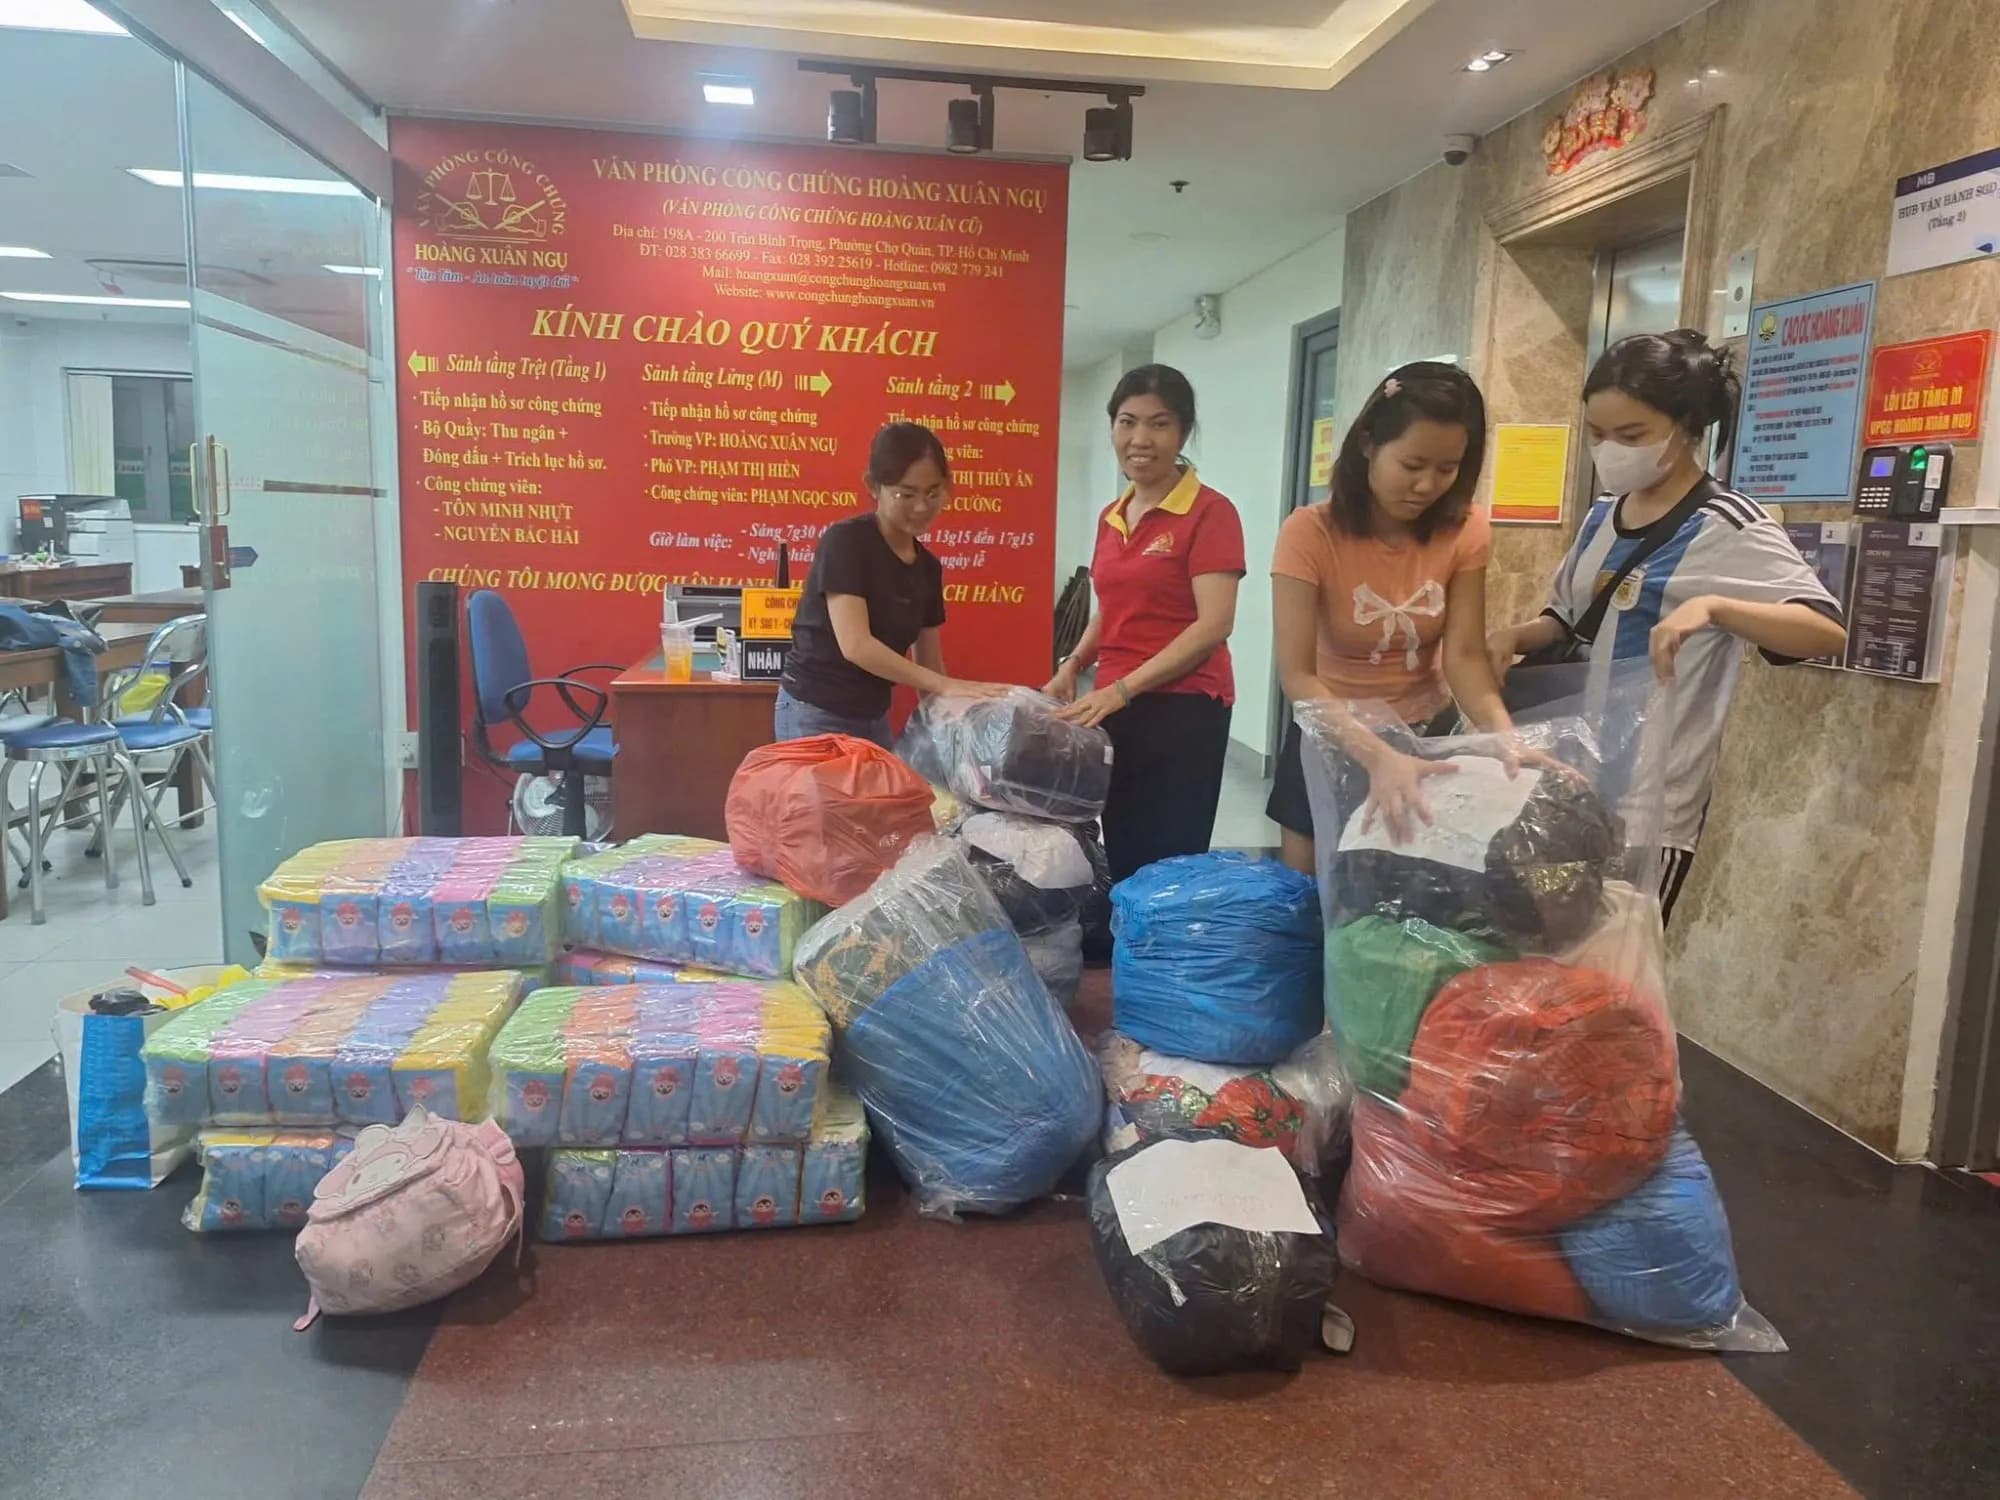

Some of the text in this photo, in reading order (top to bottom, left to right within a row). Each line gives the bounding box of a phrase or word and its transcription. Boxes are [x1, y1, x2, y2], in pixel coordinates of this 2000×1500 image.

[643, 160, 716, 186] PHÒNG
[722, 164, 782, 191] CÔNG
[788, 169, 862, 196] CHỨNG
[868, 174, 941, 202] HOÀNG
[946, 180, 1000, 205] XUÂN
[1007, 188, 1047, 214] NGỤ
[1916, 172, 1935, 189] MB
[703, 199, 754, 219] PHÒNG
[759, 203, 801, 222] CÔNG
[804, 206, 857, 227] CHỨNG
[860, 210, 912, 230] HOÀNG
[915, 214, 956, 232] XUÂN
[415, 240, 568, 272] HOÀNG XUÂN NGỤ
[640, 244, 661, 257] ĐT:
[663, 228, 694, 242] 198A
[705, 230, 725, 243] 200
[1001, 249, 1030, 263] Minh
[714, 283, 762, 299] Website:
[530, 303, 938, 357] KÍNH CHÀO QUÝ KHÁCH
[446, 351, 607, 383] Sảnh tầng Trệt (Tầng 1)
[642, 363, 679, 383] Sảnh
[683, 360, 713, 389] tầng
[758, 370, 783, 391] (M)
[886, 374, 973, 400] Sảnh tầng 2
[420, 387, 602, 418] Tiếp nhận hồ sơ công chứng
[650, 397, 818, 427] Tiếp nhận hồ sơ công chứng
[422, 416, 555, 443] Bộ Quầy: Thu ngân
[946, 411, 1039, 437] hồ sơ công chứng
[695, 431, 717, 447] VP:
[720, 430, 768, 450] HOÀNG
[770, 432, 806, 452] XUÂN
[810, 437, 838, 456] NGỤ
[957, 444, 983, 459] viên:
[423, 446, 607, 472] Đóng dấu Trích lục hồ sơ.
[676, 459, 697, 474] VP:
[700, 461, 738, 479] PHẠM
[741, 462, 765, 480] THỊ
[424, 476, 543, 497] Công chứng viên:
[952, 470, 973, 488] THỊ
[442, 498, 476, 517] TÔN
[480, 502, 524, 519] MINH
[651, 484, 858, 508] Công chứng viên: PHẠM NGỌC SƠN
[649, 531, 733, 552] Giờ làm việc:
[787, 524, 816, 541] 7g30
[428, 564, 501, 588] CHÚNG
[507, 566, 544, 589] TÔI
[546, 571, 606, 591] MONG
[609, 571, 667, 597] ĐƯỢC
[972, 580, 1024, 603] HÀNG
[747, 648, 782, 674] NHẬN
